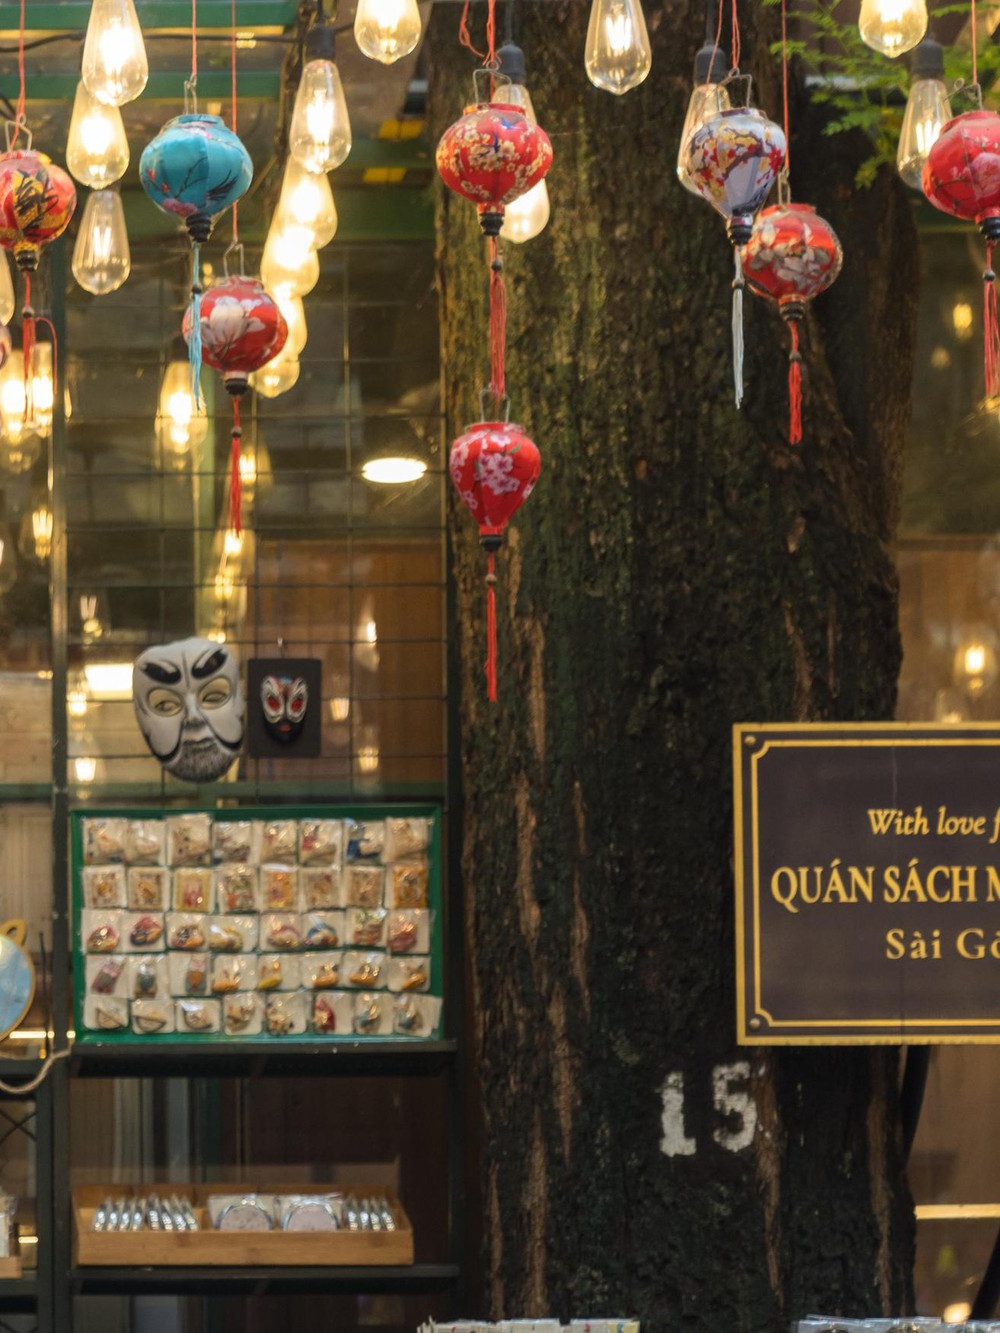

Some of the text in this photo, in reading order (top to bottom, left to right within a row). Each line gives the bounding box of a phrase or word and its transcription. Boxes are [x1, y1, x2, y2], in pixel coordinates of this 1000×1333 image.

[867, 806, 930, 837] With
[936, 806, 986, 836] love
[770, 859, 876, 913] QUÁN
[883, 858, 977, 903] SÁCH
[886, 928, 942, 960] Sài
